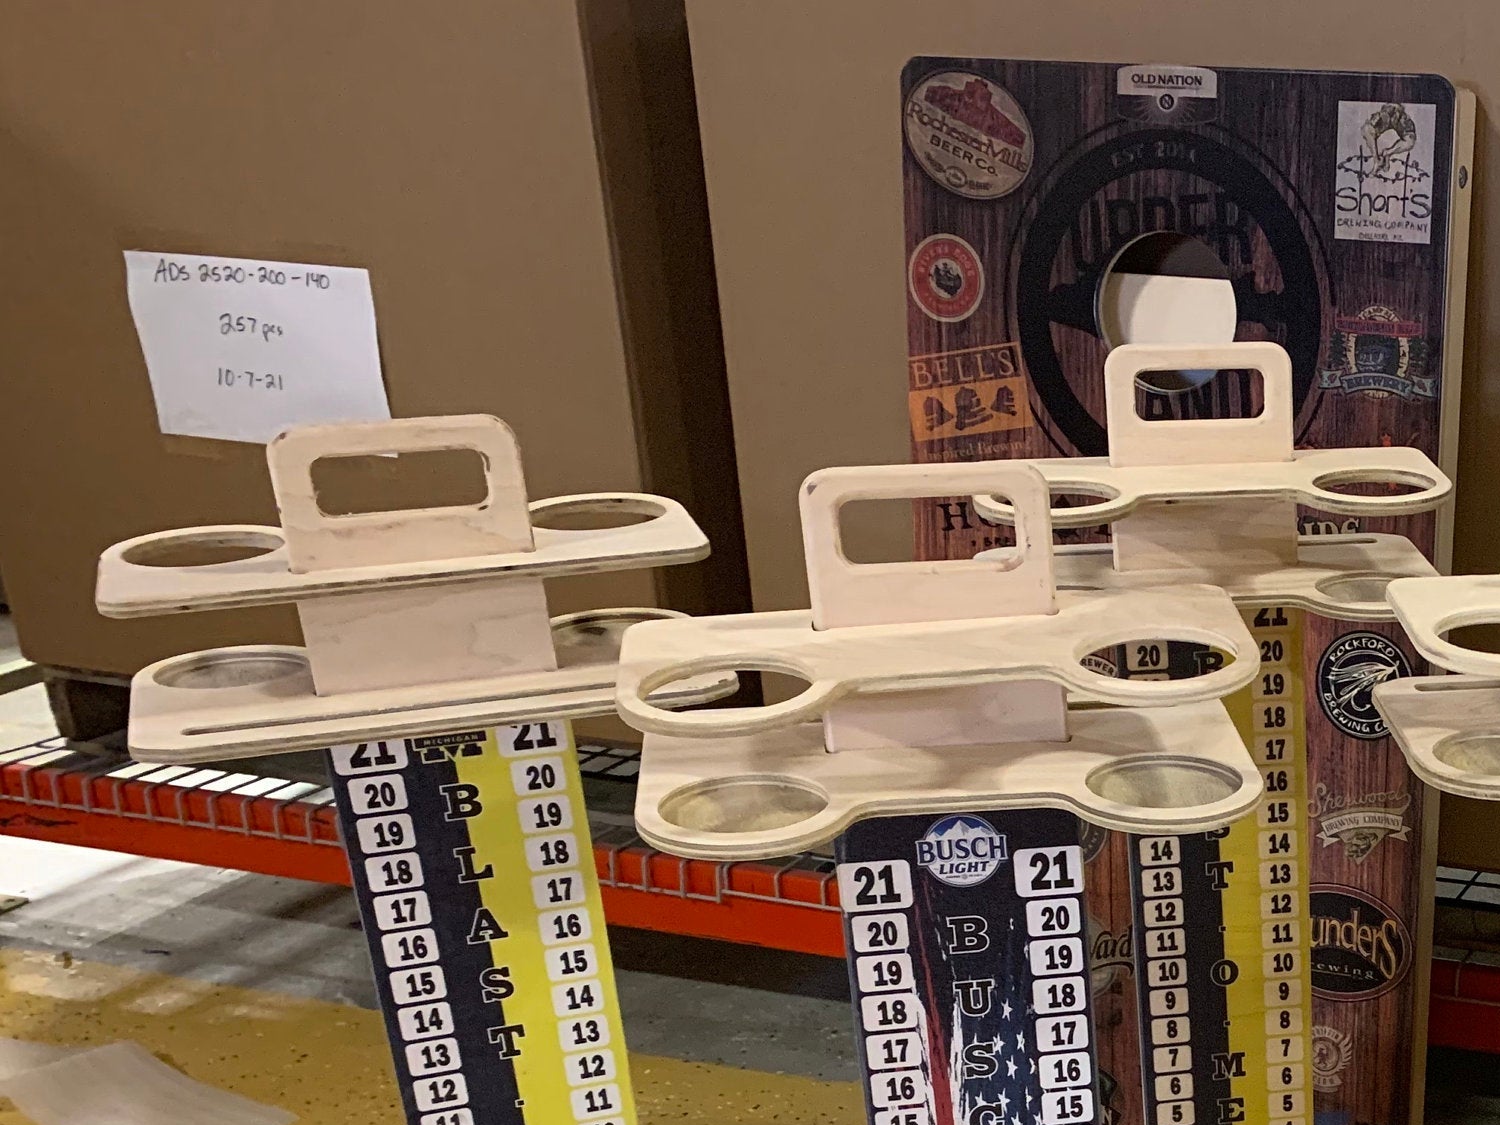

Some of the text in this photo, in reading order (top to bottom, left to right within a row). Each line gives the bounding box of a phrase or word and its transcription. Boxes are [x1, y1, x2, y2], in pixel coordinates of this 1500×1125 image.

[1131, 73, 1203, 86] OLD NATION
[930, 134, 974, 164] BEER
[1335, 186, 1432, 219] Short's
[219, 313, 257, 335] 257
[911, 349, 1015, 389] BELL'S
[1136, 644, 1161, 668] 20
[1259, 640, 1284, 662] 20
[1328, 638, 1395, 662] ROCKFORD
[1261, 672, 1285, 696] 19
[1323, 692, 1370, 733] BREWING
[1265, 739, 1287, 761] 17
[526, 763, 556, 791] 20
[364, 781, 396, 810] 20
[916, 834, 1007, 865] BUSCH
[1150, 839, 1174, 862] 14
[1268, 832, 1291, 855] 14
[939, 861, 990, 875] LIGHT
[1029, 850, 1075, 891] 21
[547, 876, 573, 903] 17
[853, 864, 902, 906] 21
[390, 897, 417, 925] 17
[1154, 901, 1177, 923] 12
[1270, 893, 1292, 915] 12
[1040, 905, 1070, 932] 20
[867, 920, 898, 948] 20
[1310, 907, 1398, 980] unders
[1316, 963, 1374, 980] ewing
[1047, 983, 1076, 1009] 18
[877, 999, 908, 1026] 18
[572, 1019, 600, 1045] 13
[421, 1043, 451, 1070] 13
